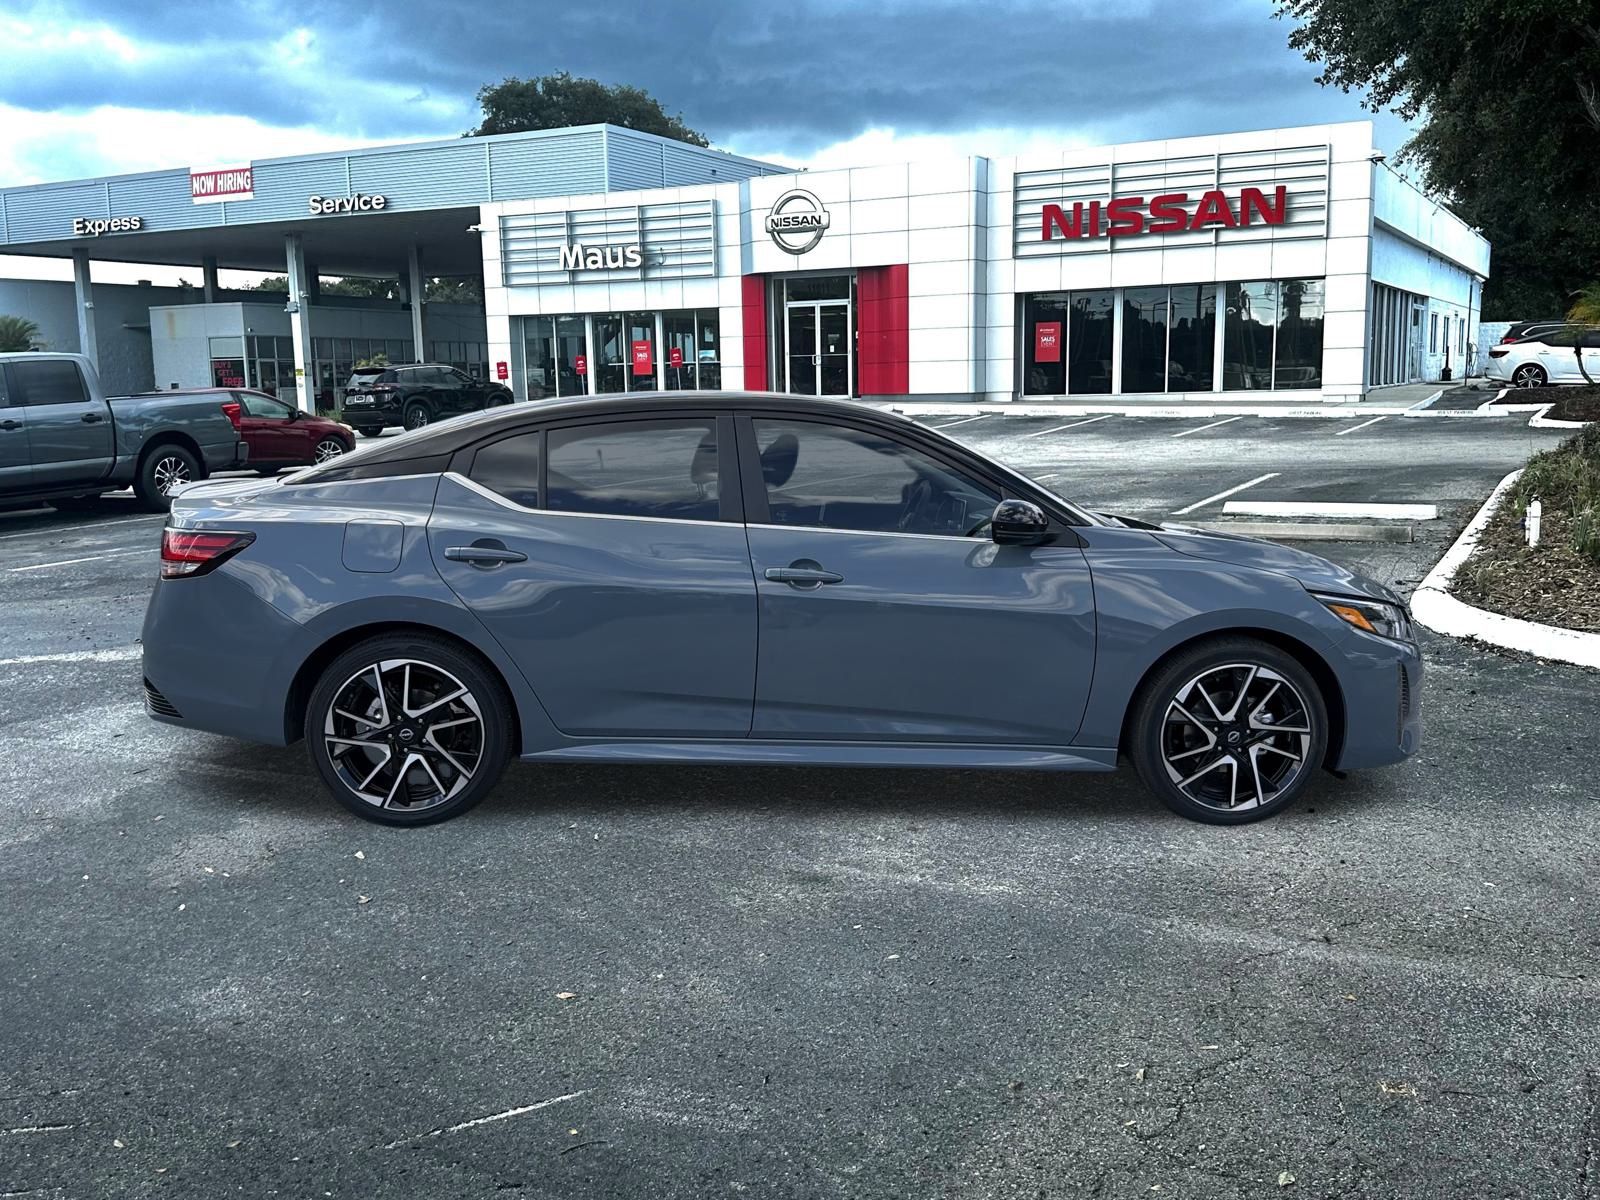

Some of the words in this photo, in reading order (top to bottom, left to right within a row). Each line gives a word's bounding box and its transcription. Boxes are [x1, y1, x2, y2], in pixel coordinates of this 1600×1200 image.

[191, 175, 215, 195] NOW
[216, 170, 251, 192] HIRING
[308, 193, 386, 215] Service
[1041, 185, 1287, 241] NISSAN
[72, 215, 141, 237] Express
[769, 214, 823, 230] NISSAN
[558, 243, 643, 271] Maus
[222, 377, 244, 387] FREE
